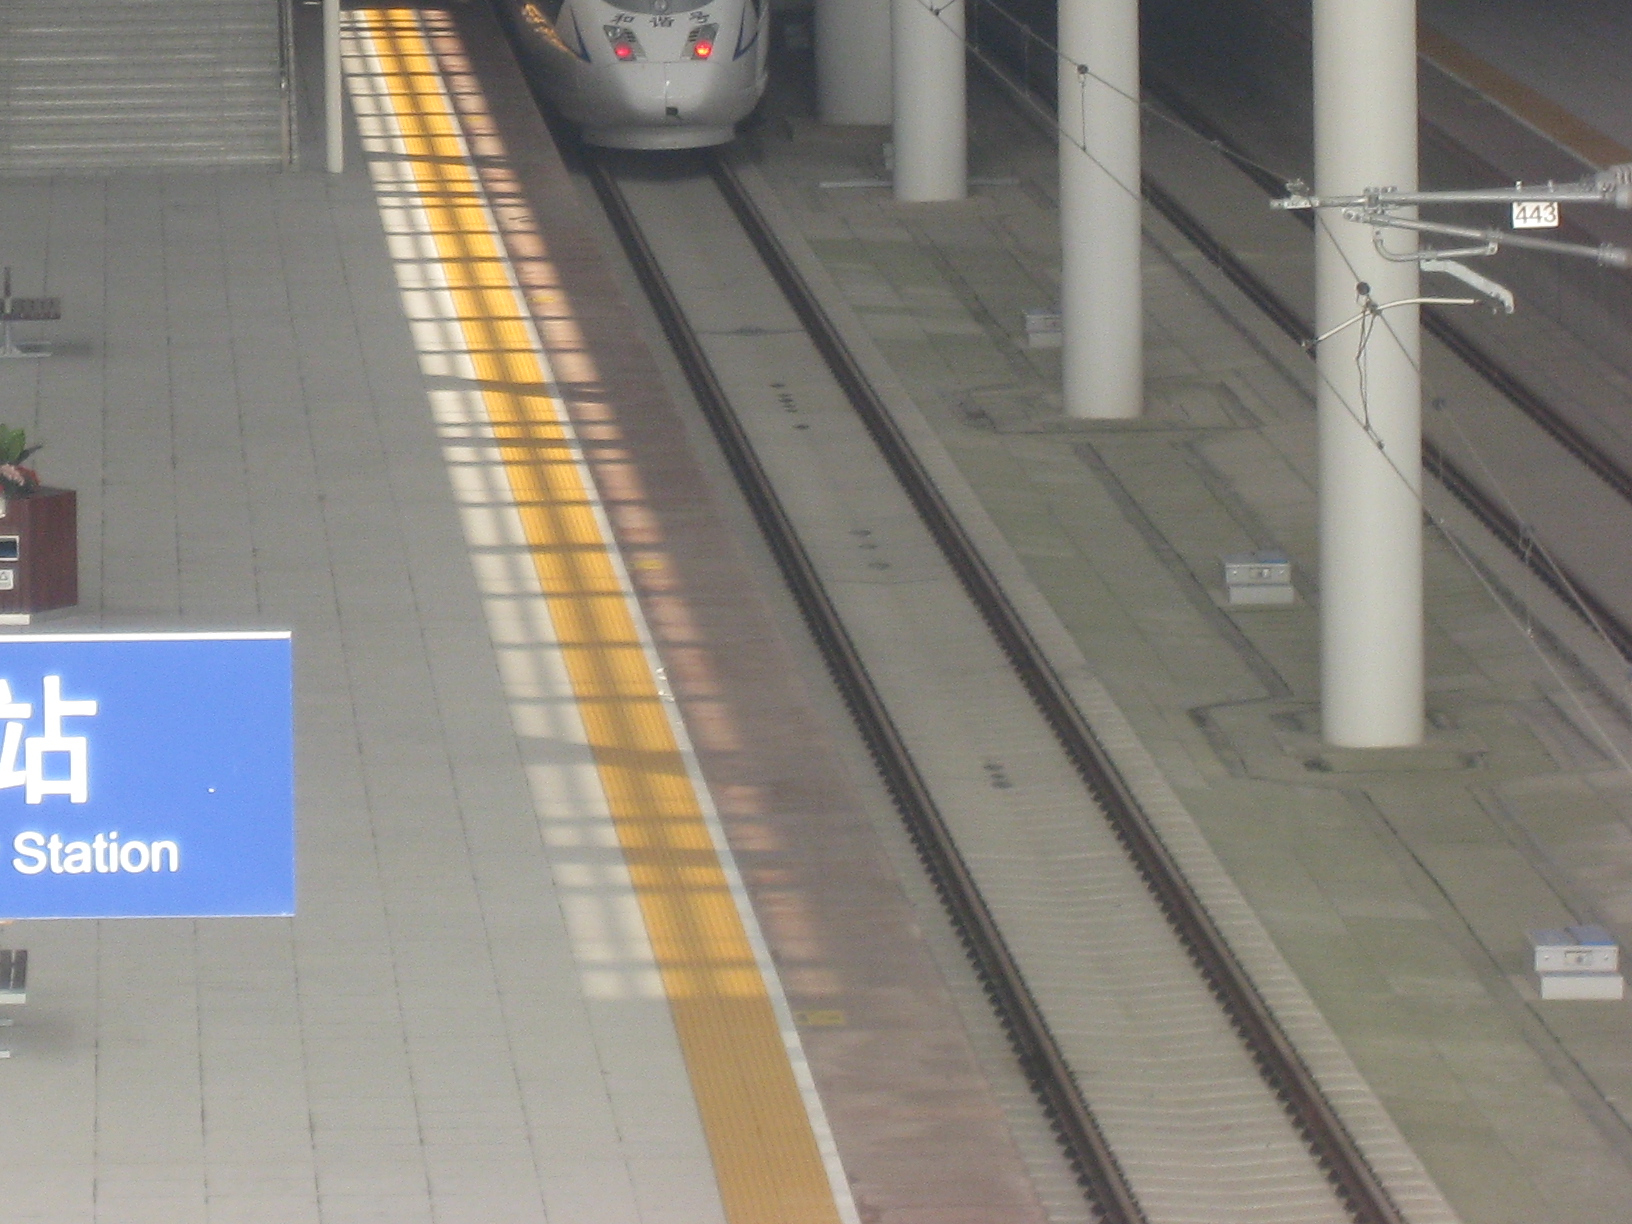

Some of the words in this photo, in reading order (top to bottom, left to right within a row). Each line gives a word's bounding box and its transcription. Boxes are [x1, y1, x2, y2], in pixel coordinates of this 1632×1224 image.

[610, 11, 710, 28] 和谐号
[1515, 204, 1557, 224] 443
[14, 832, 178, 874] Station
